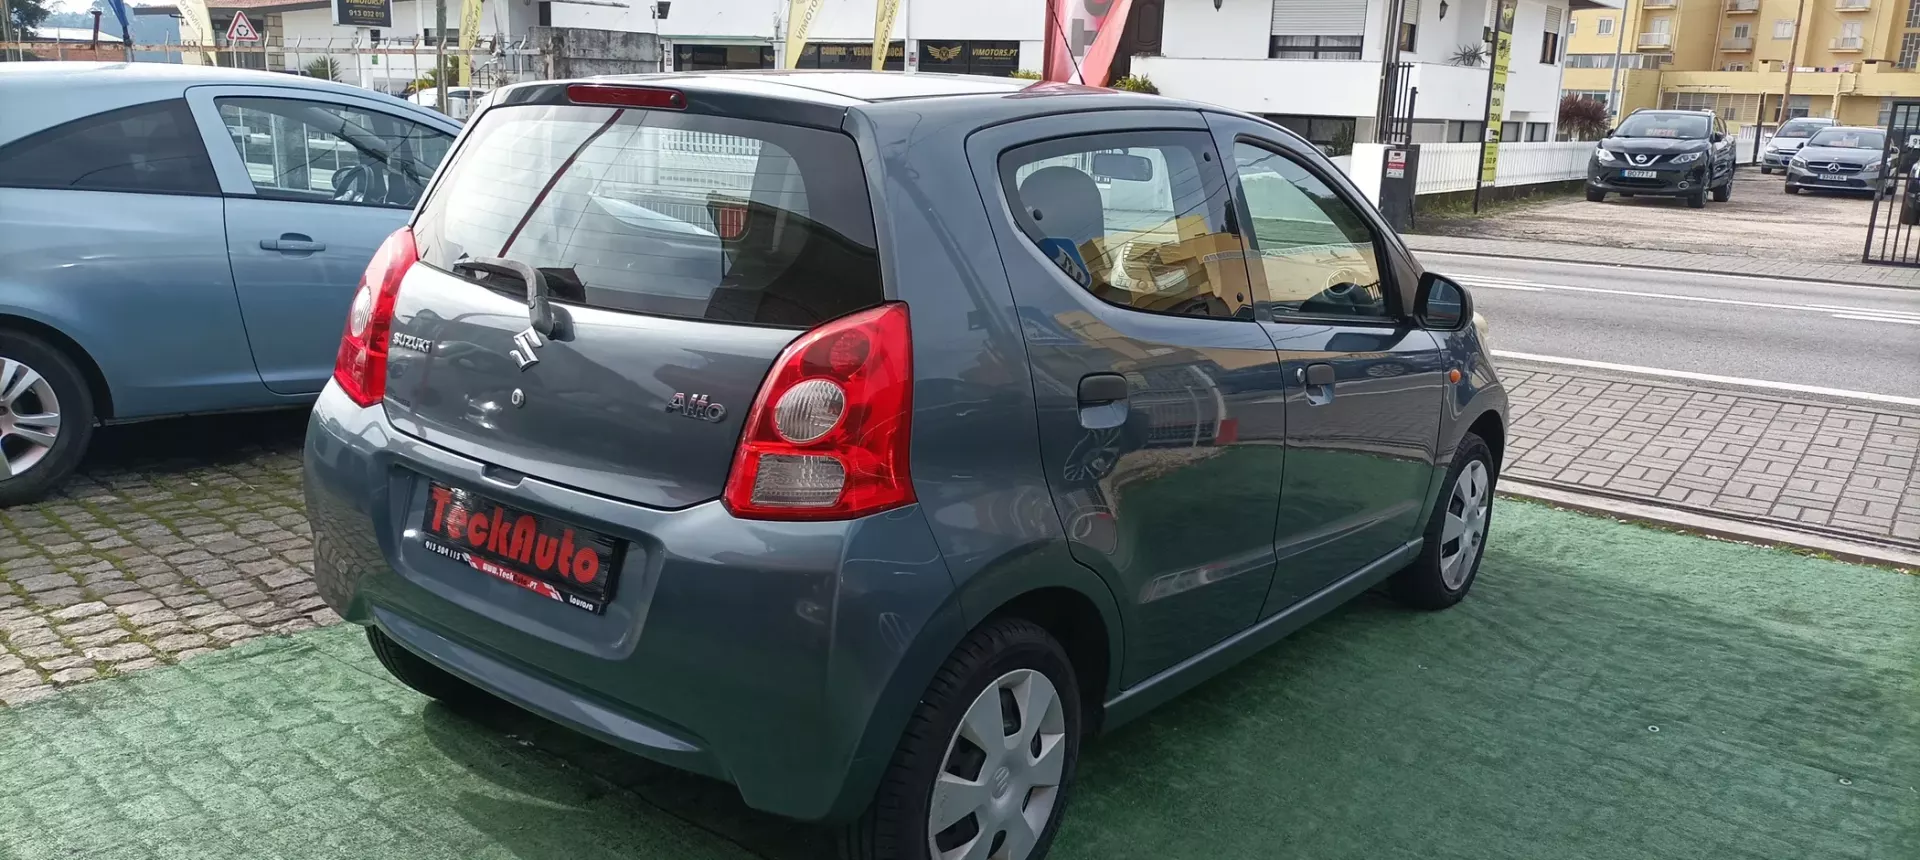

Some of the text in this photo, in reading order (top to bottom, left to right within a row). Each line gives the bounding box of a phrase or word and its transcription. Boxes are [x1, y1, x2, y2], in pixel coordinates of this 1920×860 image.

[392, 332, 432, 354] SUZUKI
[665, 392, 728, 424] Alto
[430, 486, 599, 584] TeckAuto
